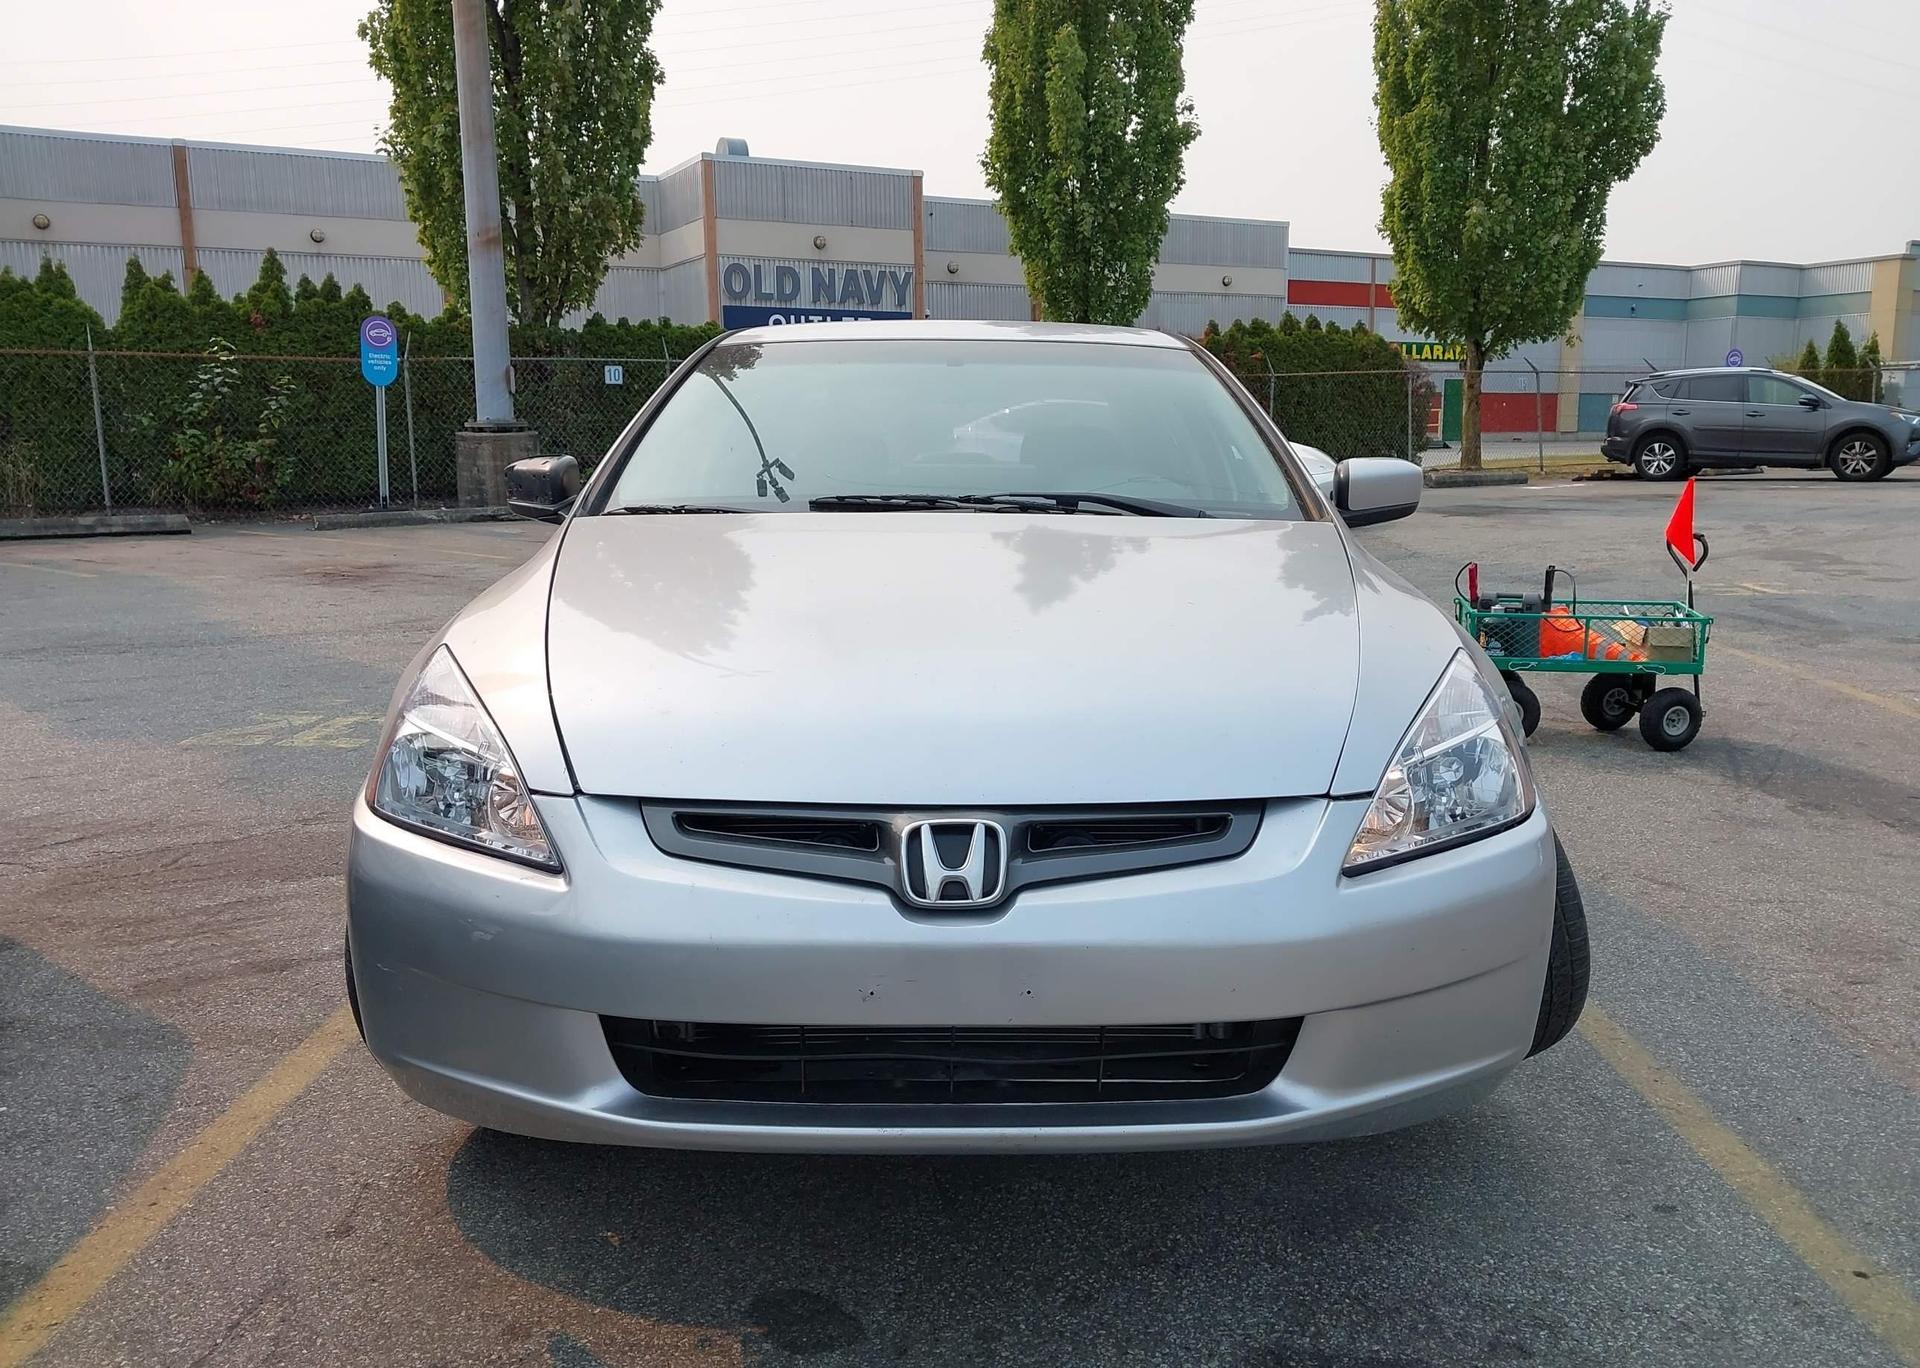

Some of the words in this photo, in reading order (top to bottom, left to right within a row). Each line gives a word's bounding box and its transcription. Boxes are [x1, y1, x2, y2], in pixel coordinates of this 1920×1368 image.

[723, 262, 801, 301] OLD
[811, 267, 913, 307] NAVY
[607, 367, 620, 382] 10
